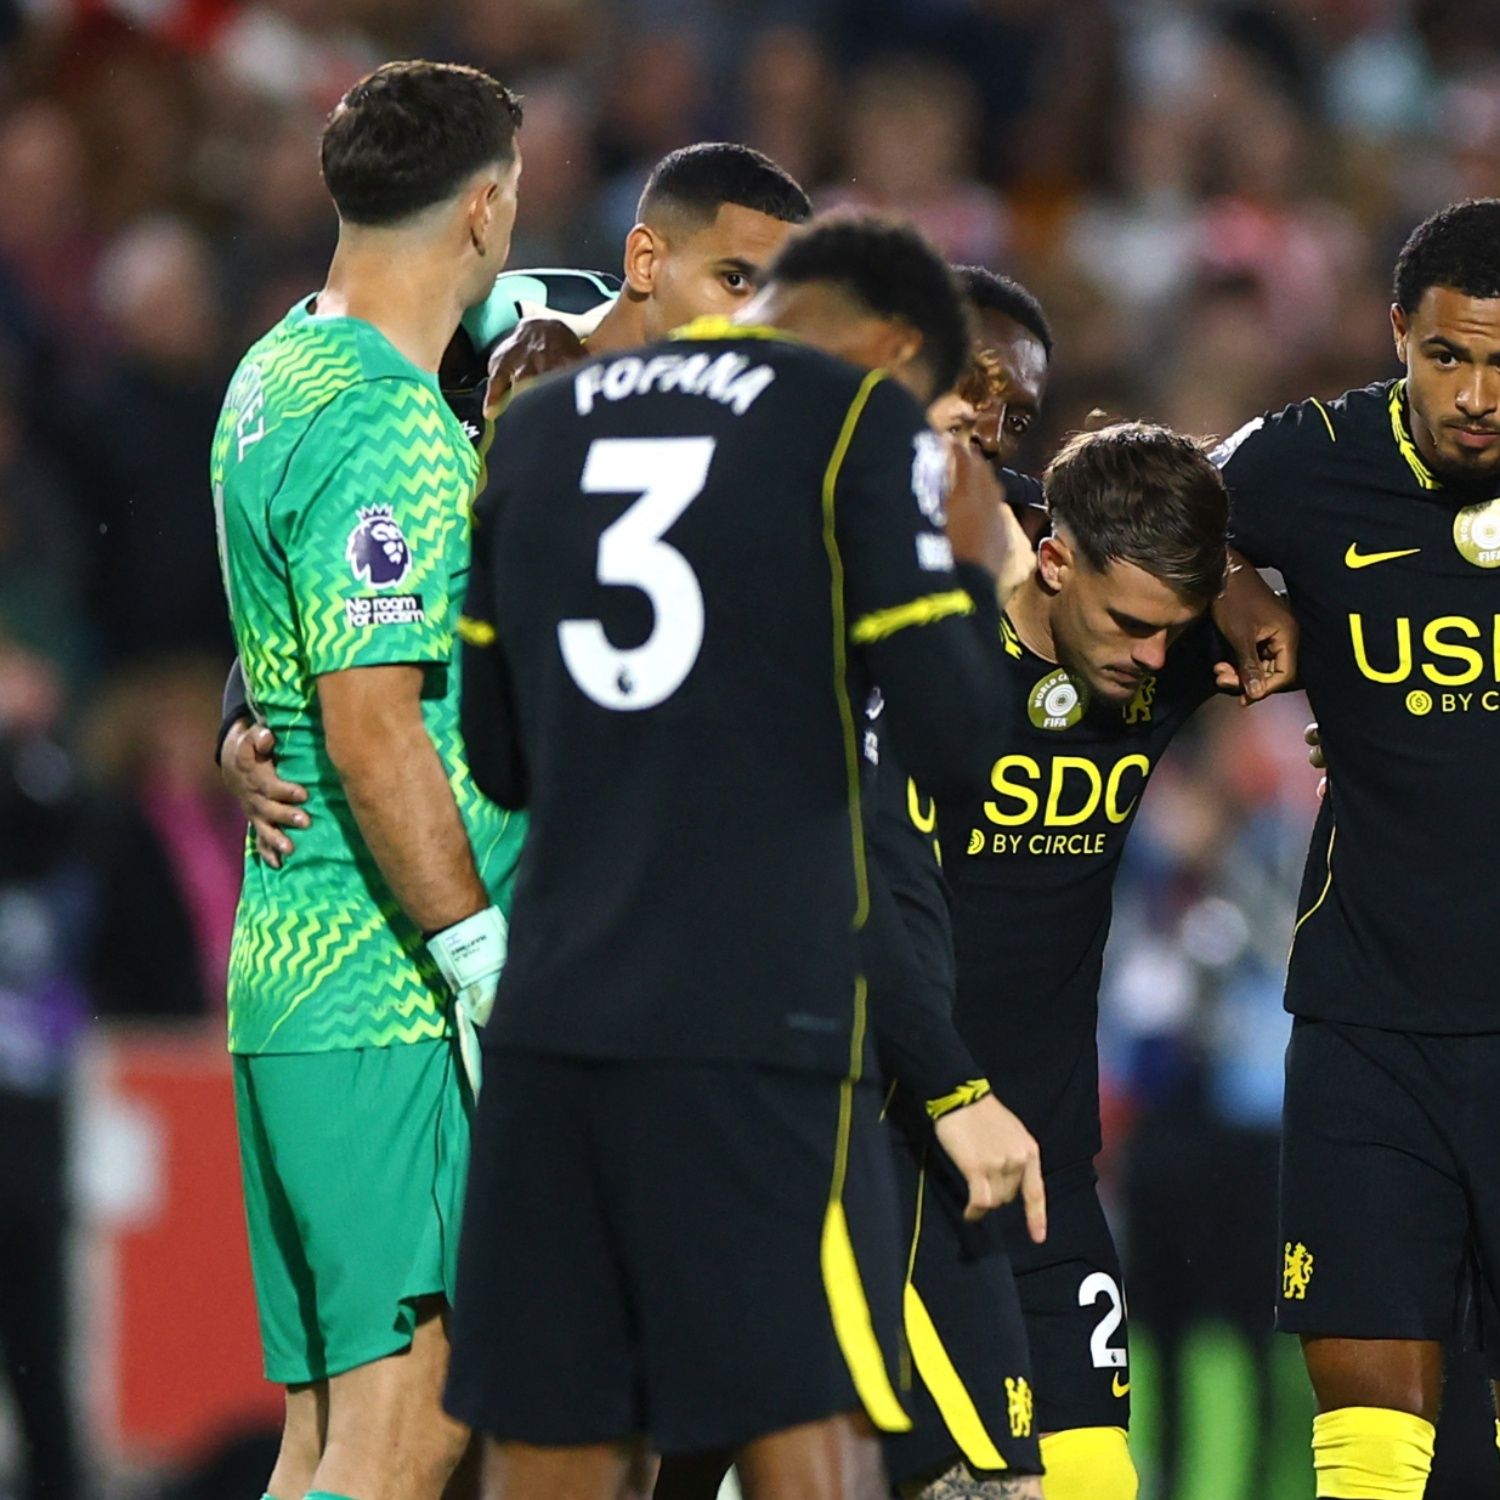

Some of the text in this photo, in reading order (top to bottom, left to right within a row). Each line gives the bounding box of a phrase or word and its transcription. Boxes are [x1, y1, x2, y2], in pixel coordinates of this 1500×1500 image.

[575, 352, 775, 416] FOFANA
[557, 436, 716, 712] 3
[346, 597, 417, 614] No room
[373, 608, 424, 624] racism
[1034, 678, 1057, 708] WORLD
[1441, 693, 1473, 712] BY
[1043, 717, 1067, 728] FIFA
[993, 833, 1106, 854] BY CIRCLE
